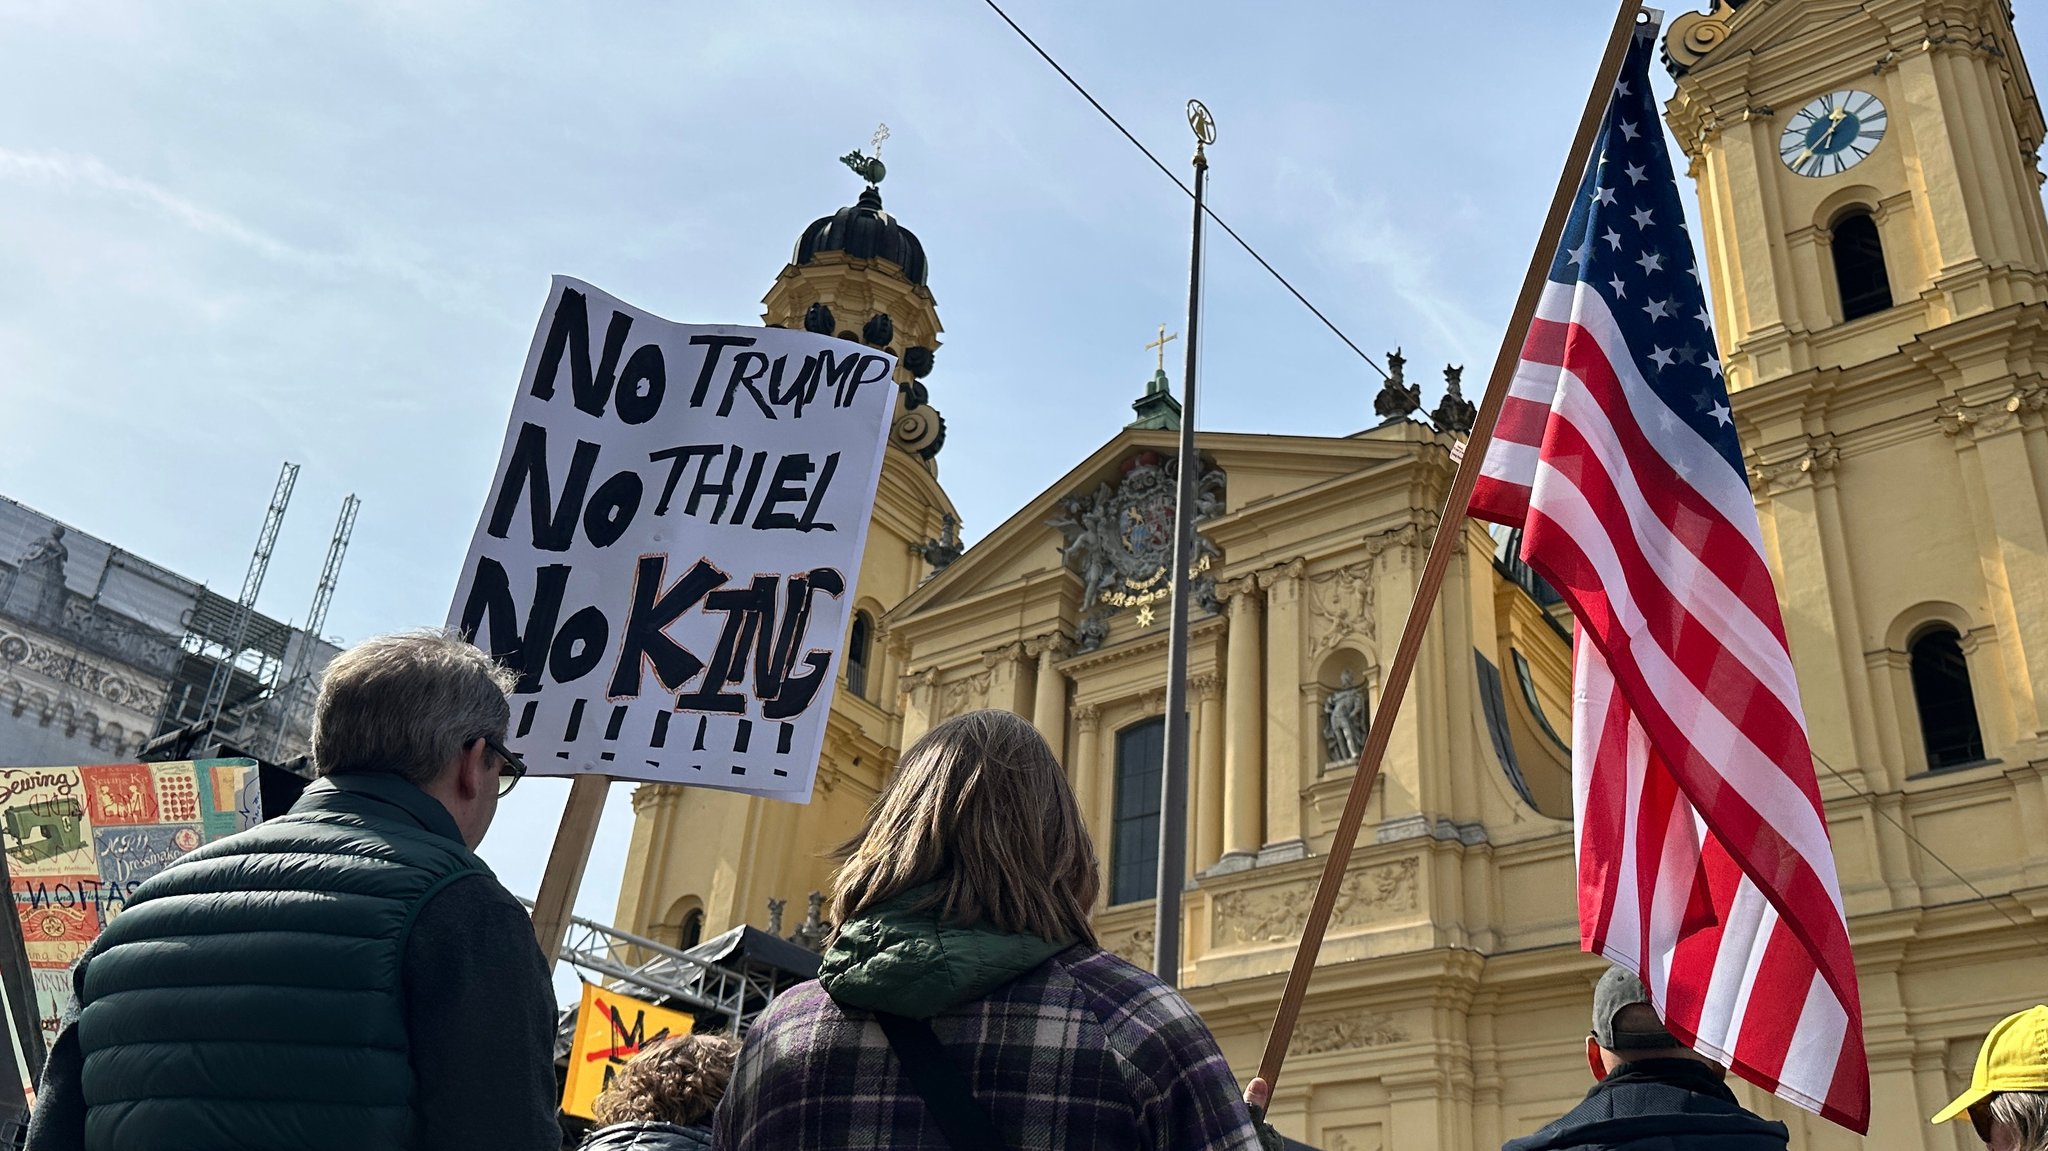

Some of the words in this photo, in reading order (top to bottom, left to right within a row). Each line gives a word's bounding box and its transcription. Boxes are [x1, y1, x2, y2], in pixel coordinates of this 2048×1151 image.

[689, 334, 891, 420] TRUMP
[649, 443, 841, 532] THIEL
[607, 552, 846, 720] KING
